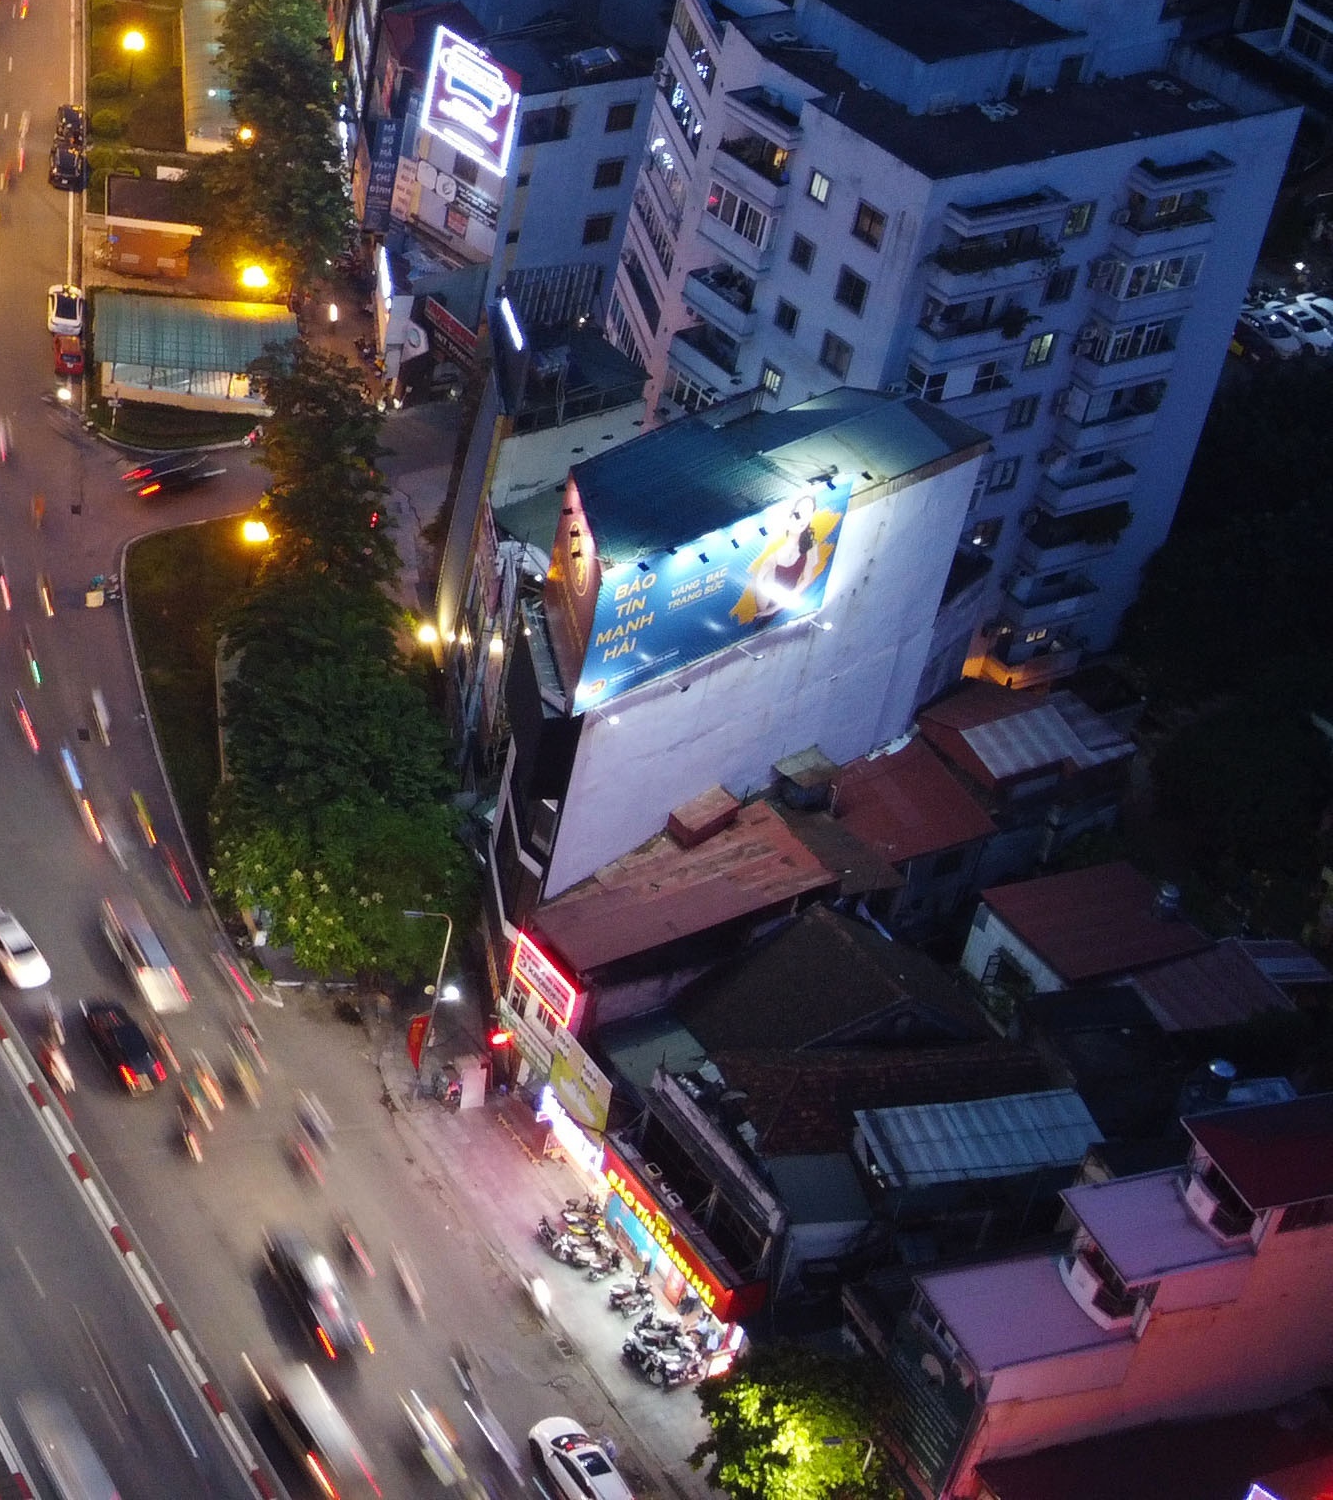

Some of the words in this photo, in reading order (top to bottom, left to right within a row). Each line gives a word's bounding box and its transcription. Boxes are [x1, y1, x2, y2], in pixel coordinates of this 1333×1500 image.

[613, 572, 658, 602] BẢO
[667, 590, 704, 611] TRANG
[670, 578, 702, 598] VÀNG
[615, 595, 647, 619] TÍN
[595, 611, 656, 648] MẠNH
[602, 635, 638, 663] HẢI
[606, 1169, 636, 1207] BẢO
